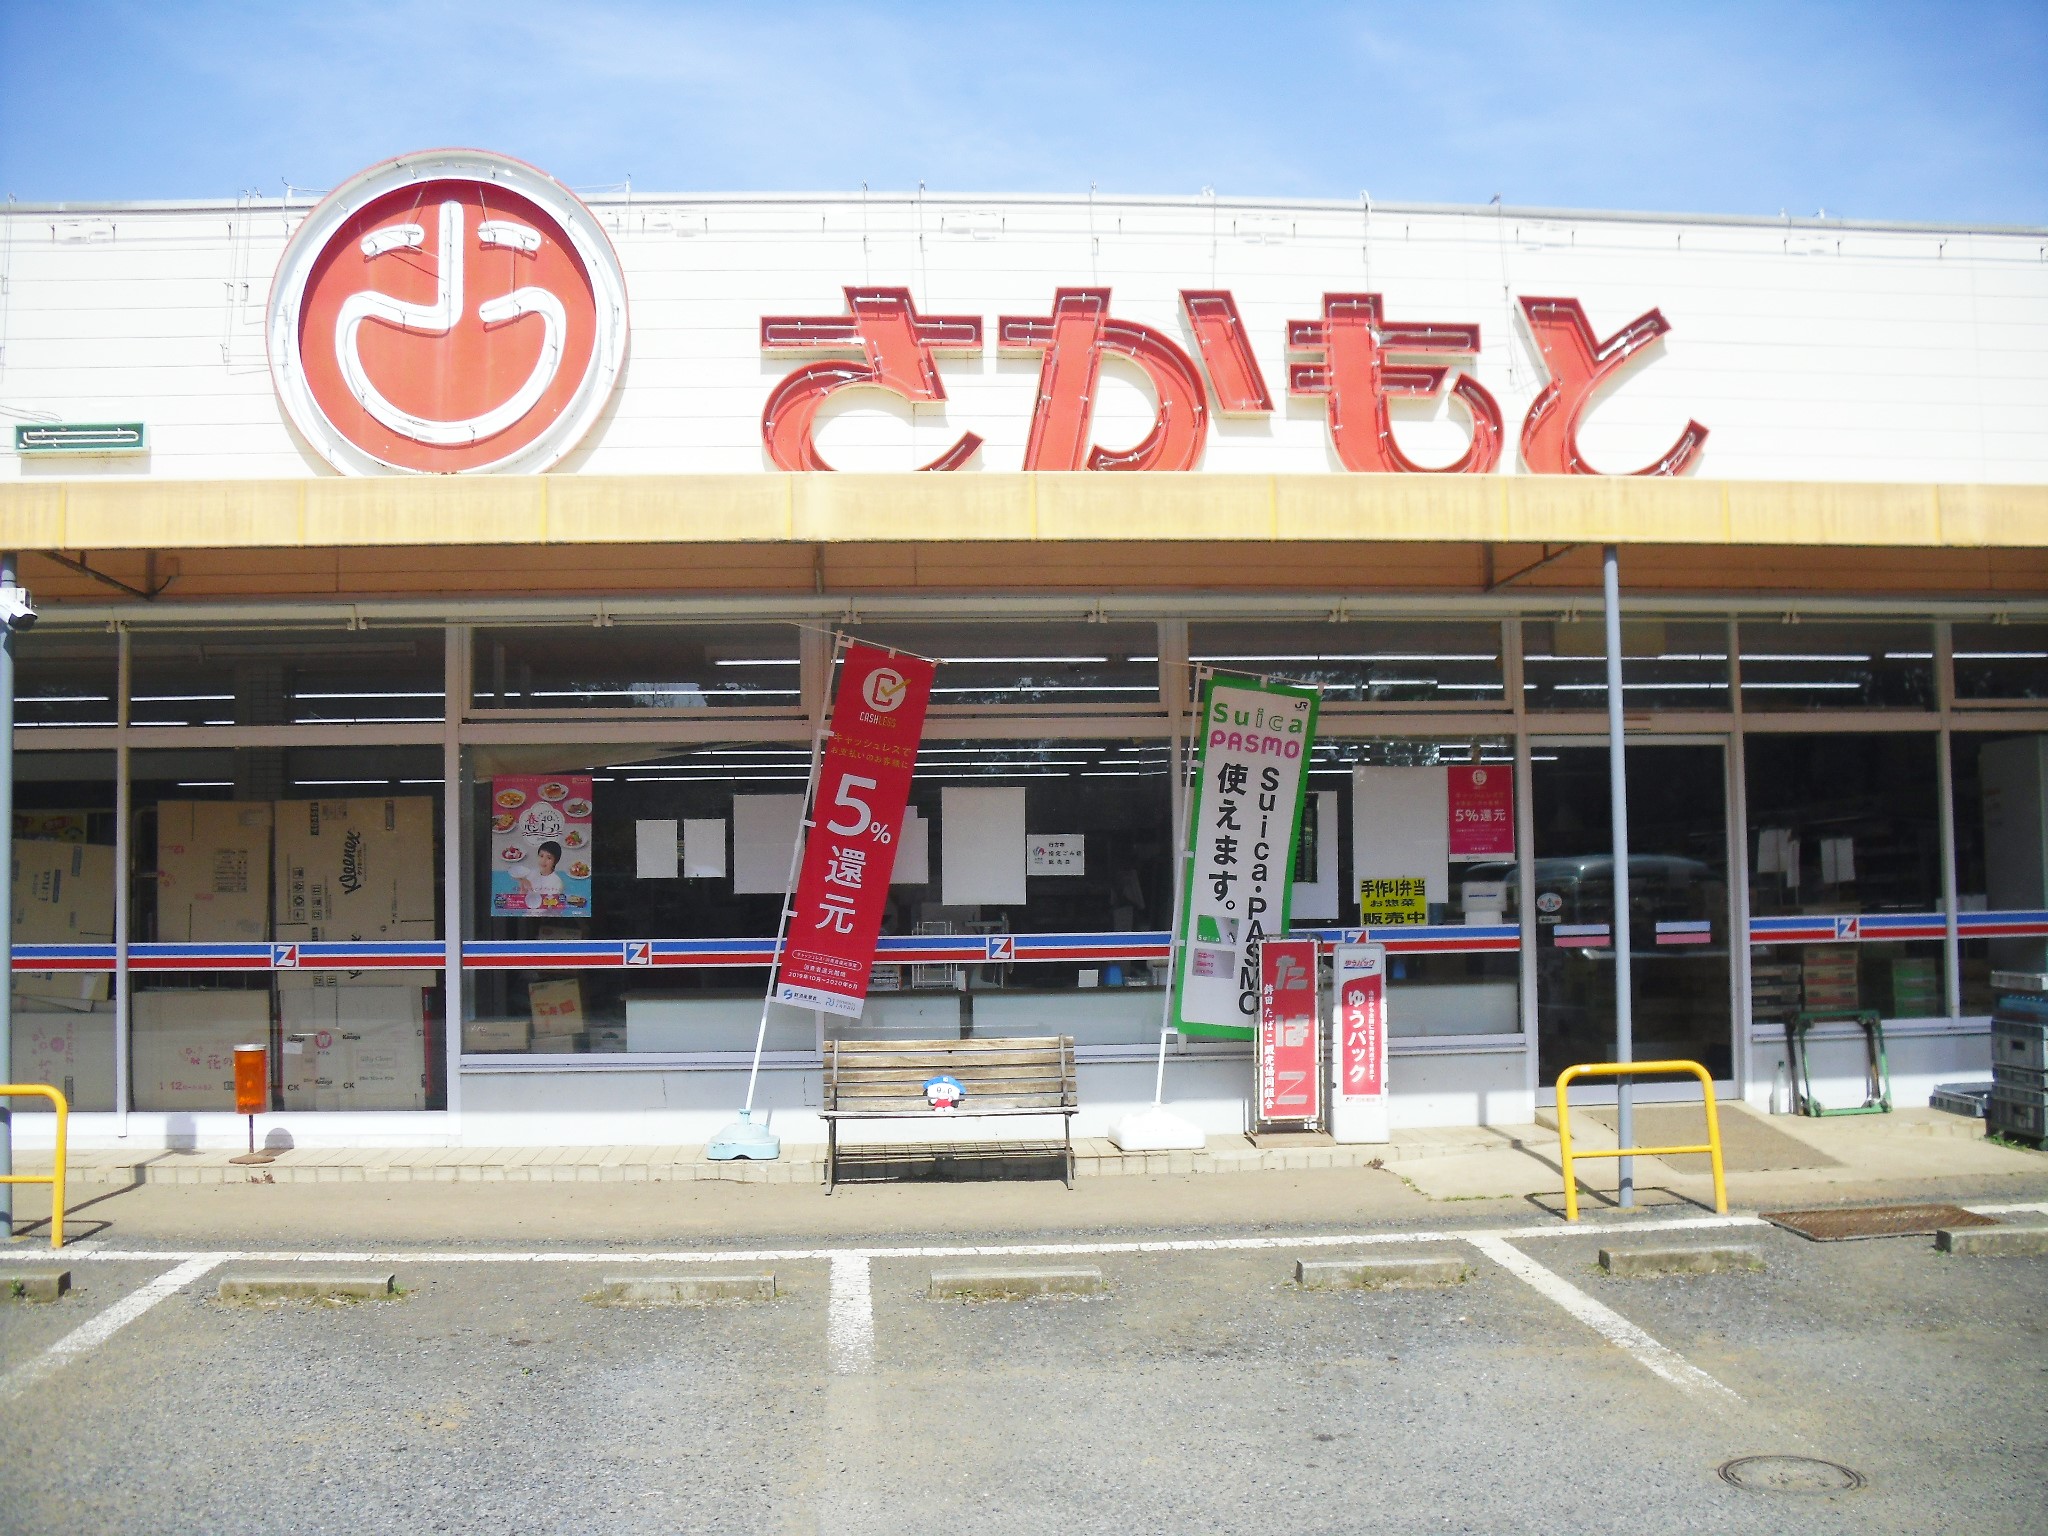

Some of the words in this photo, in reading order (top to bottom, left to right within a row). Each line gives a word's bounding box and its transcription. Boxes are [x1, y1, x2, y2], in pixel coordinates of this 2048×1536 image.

[761, 286, 1709, 474] さかもと
[860, 711, 897, 729] CASHLESS
[1213, 702, 1303, 734] Suica
[1209, 729, 1300, 759] PASMO
[1455, 808, 1506, 823] 5%還元
[1208, 762, 1249, 911] 使えます。
[339, 829, 361, 895] Kleenex
[1361, 879, 1426, 898] 手作り弁当
[1370, 898, 1415, 908] お惣菜
[1363, 911, 1426, 925] 販売中
[1348, 989, 1366, 1083] ゆうパック
